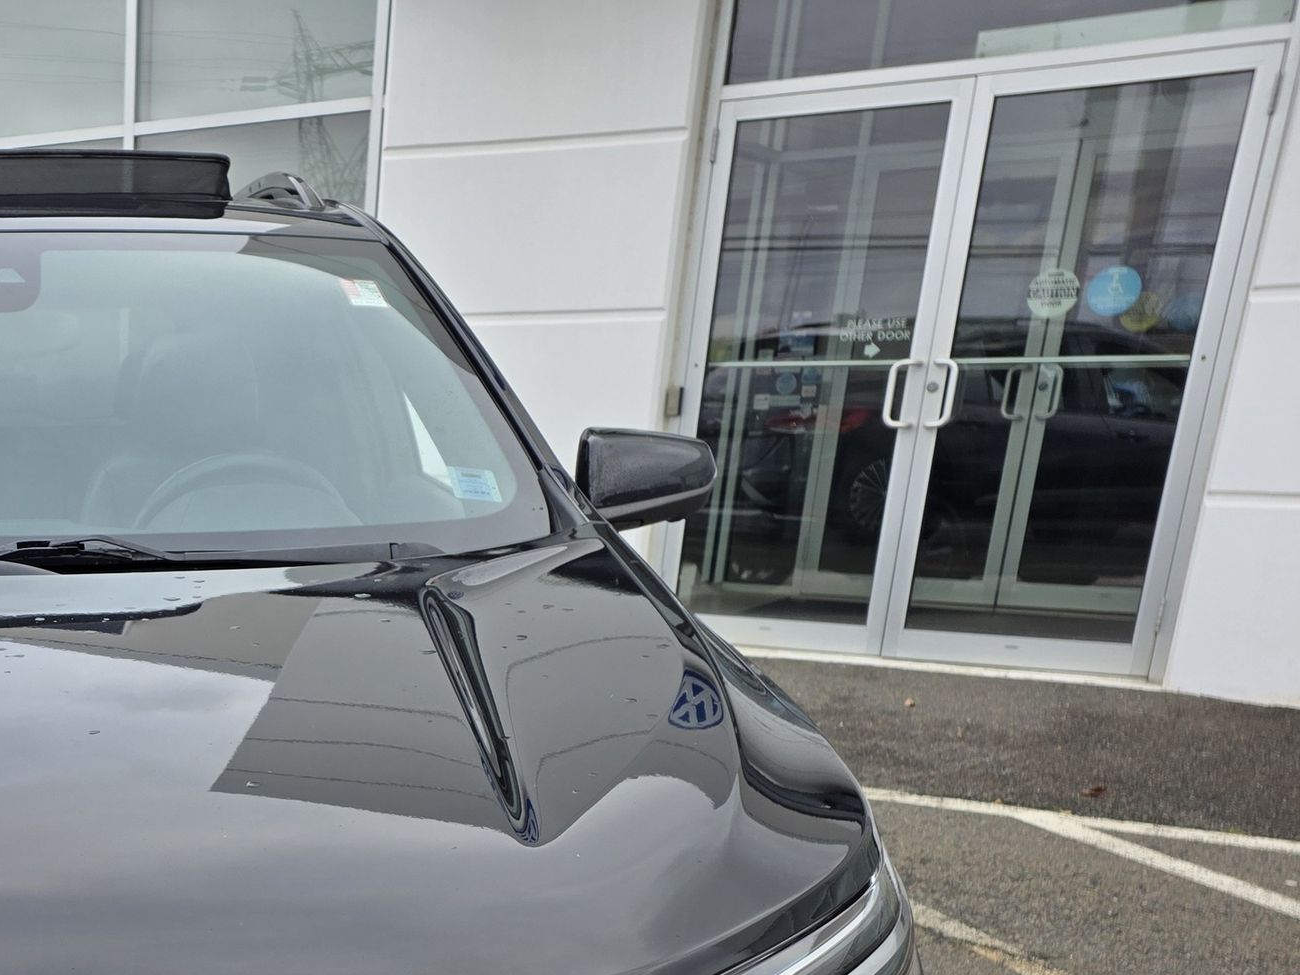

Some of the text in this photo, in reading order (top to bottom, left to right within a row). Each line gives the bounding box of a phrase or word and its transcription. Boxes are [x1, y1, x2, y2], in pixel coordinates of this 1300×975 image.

[1028, 287, 1079, 298] CAUTION
[847, 318, 907, 330] PLEASE USE
[839, 329, 911, 342] OTHER DOOR
